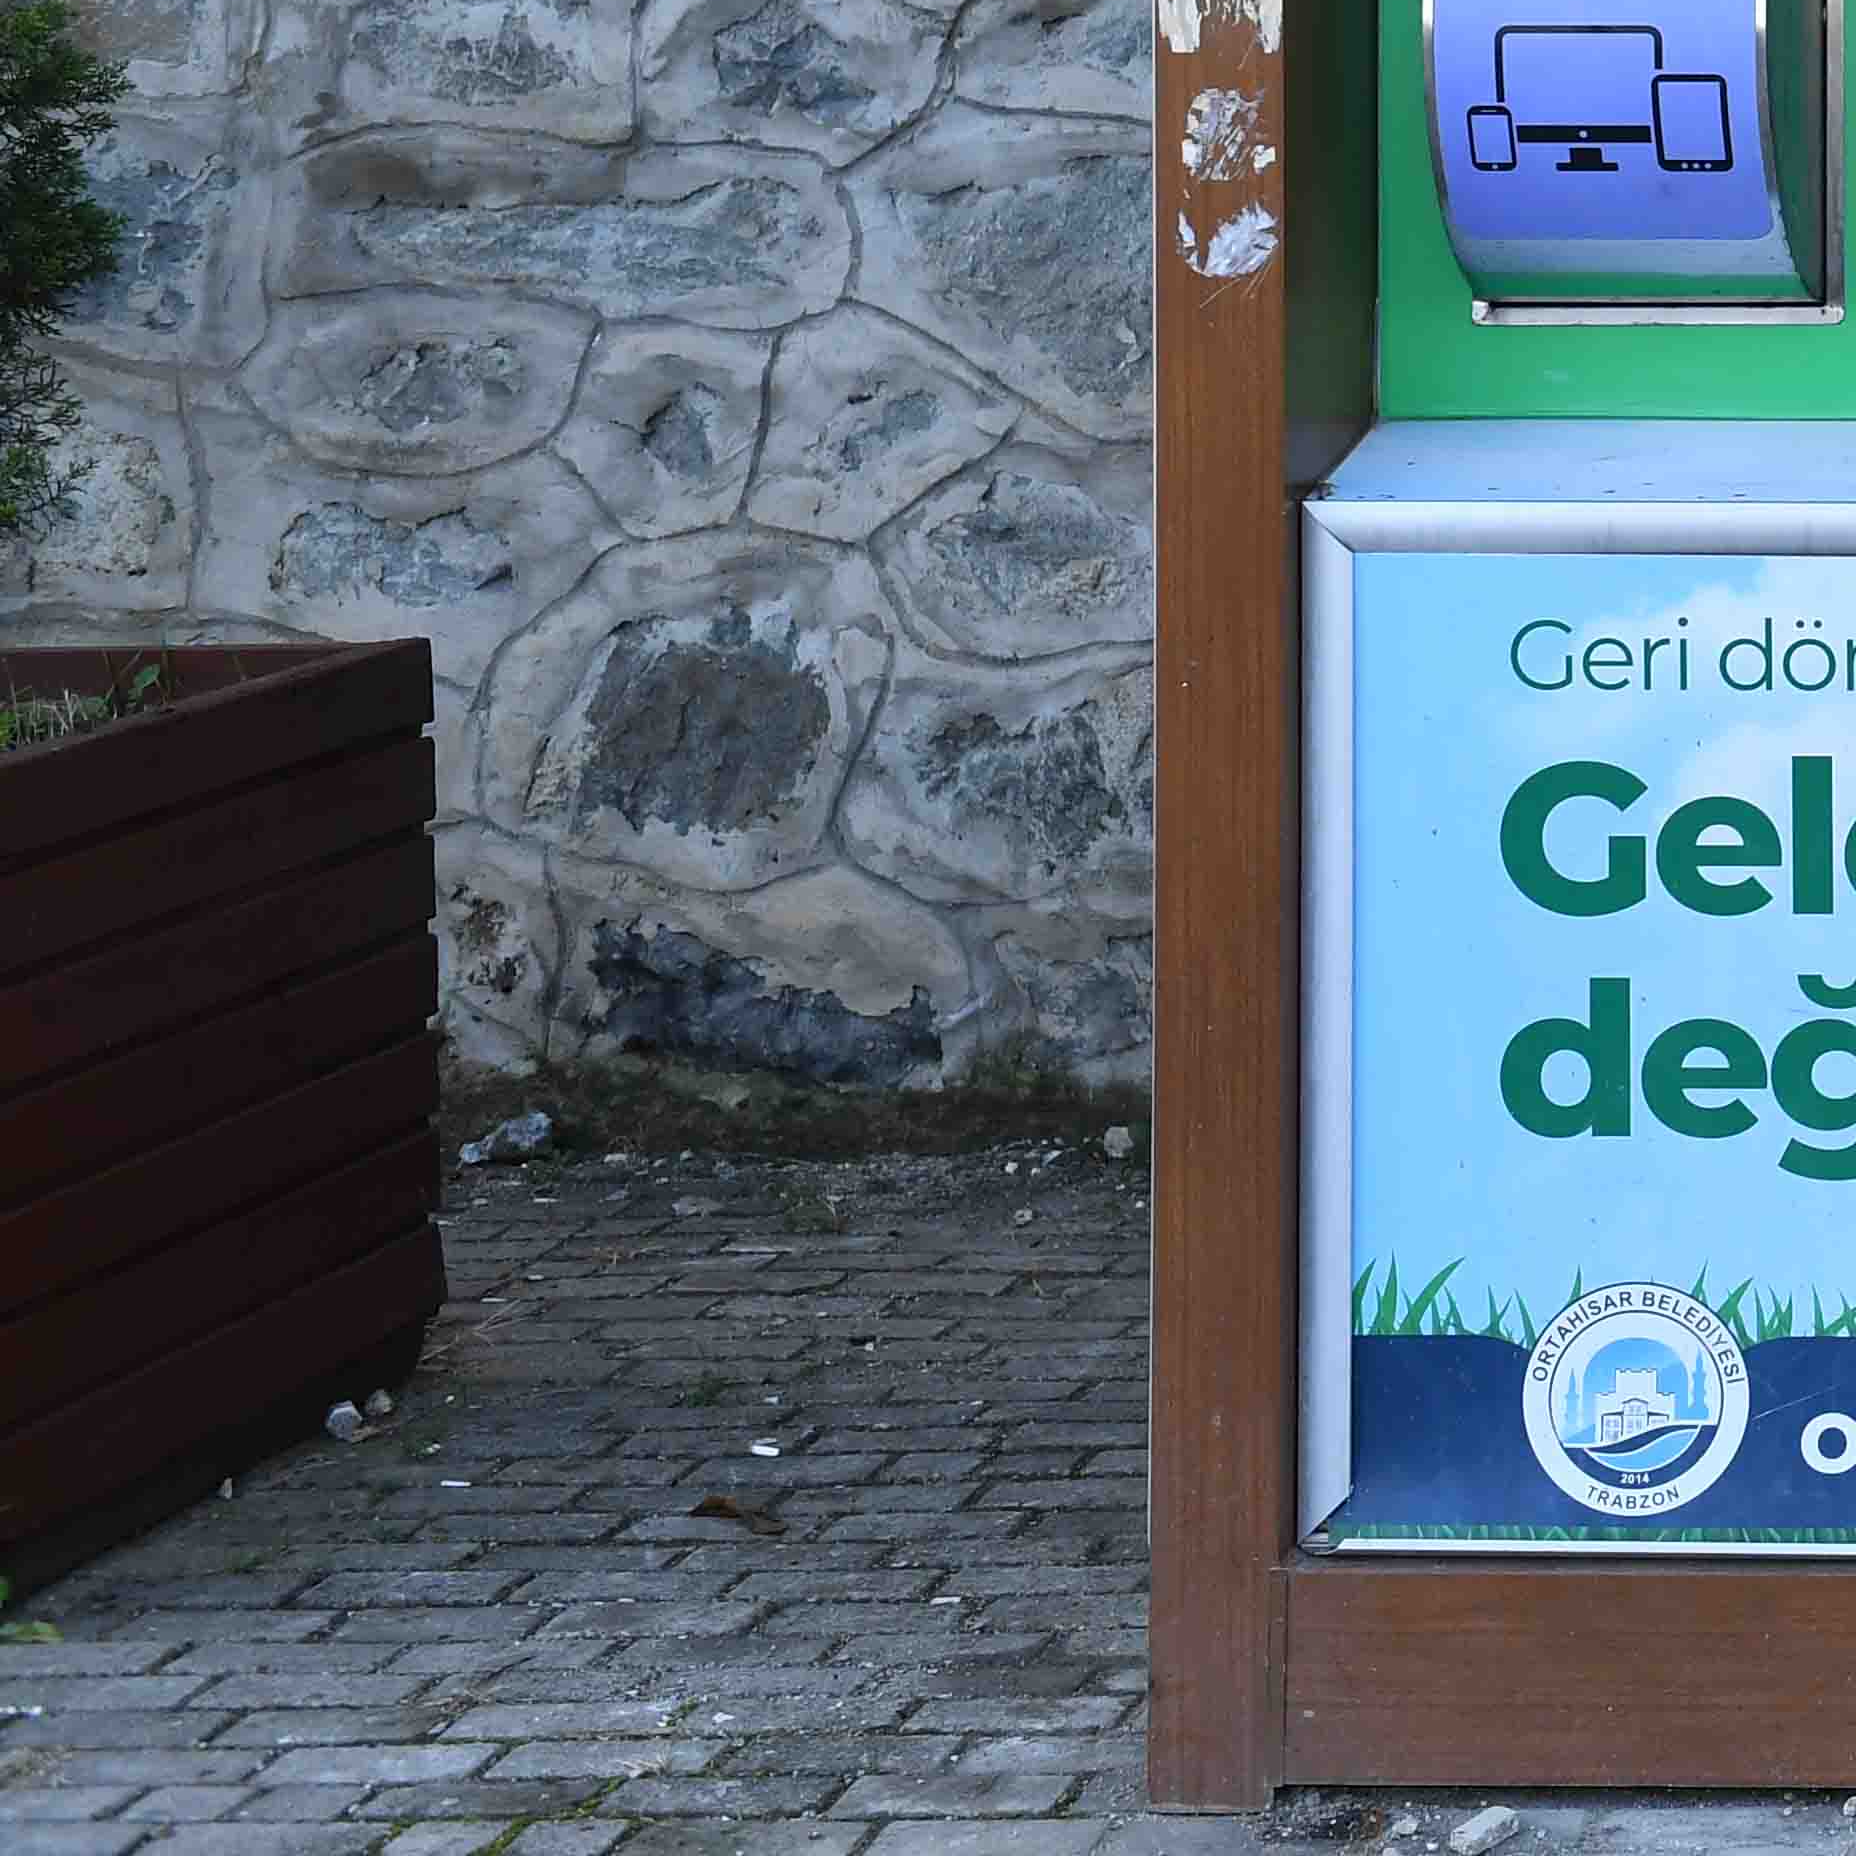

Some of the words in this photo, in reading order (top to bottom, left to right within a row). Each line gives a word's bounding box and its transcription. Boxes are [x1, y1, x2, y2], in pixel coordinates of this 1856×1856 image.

[1509, 617, 1690, 696] Geri
[1620, 1472, 1650, 1485] 2014
[1588, 1485, 1680, 1510] TRABZON
